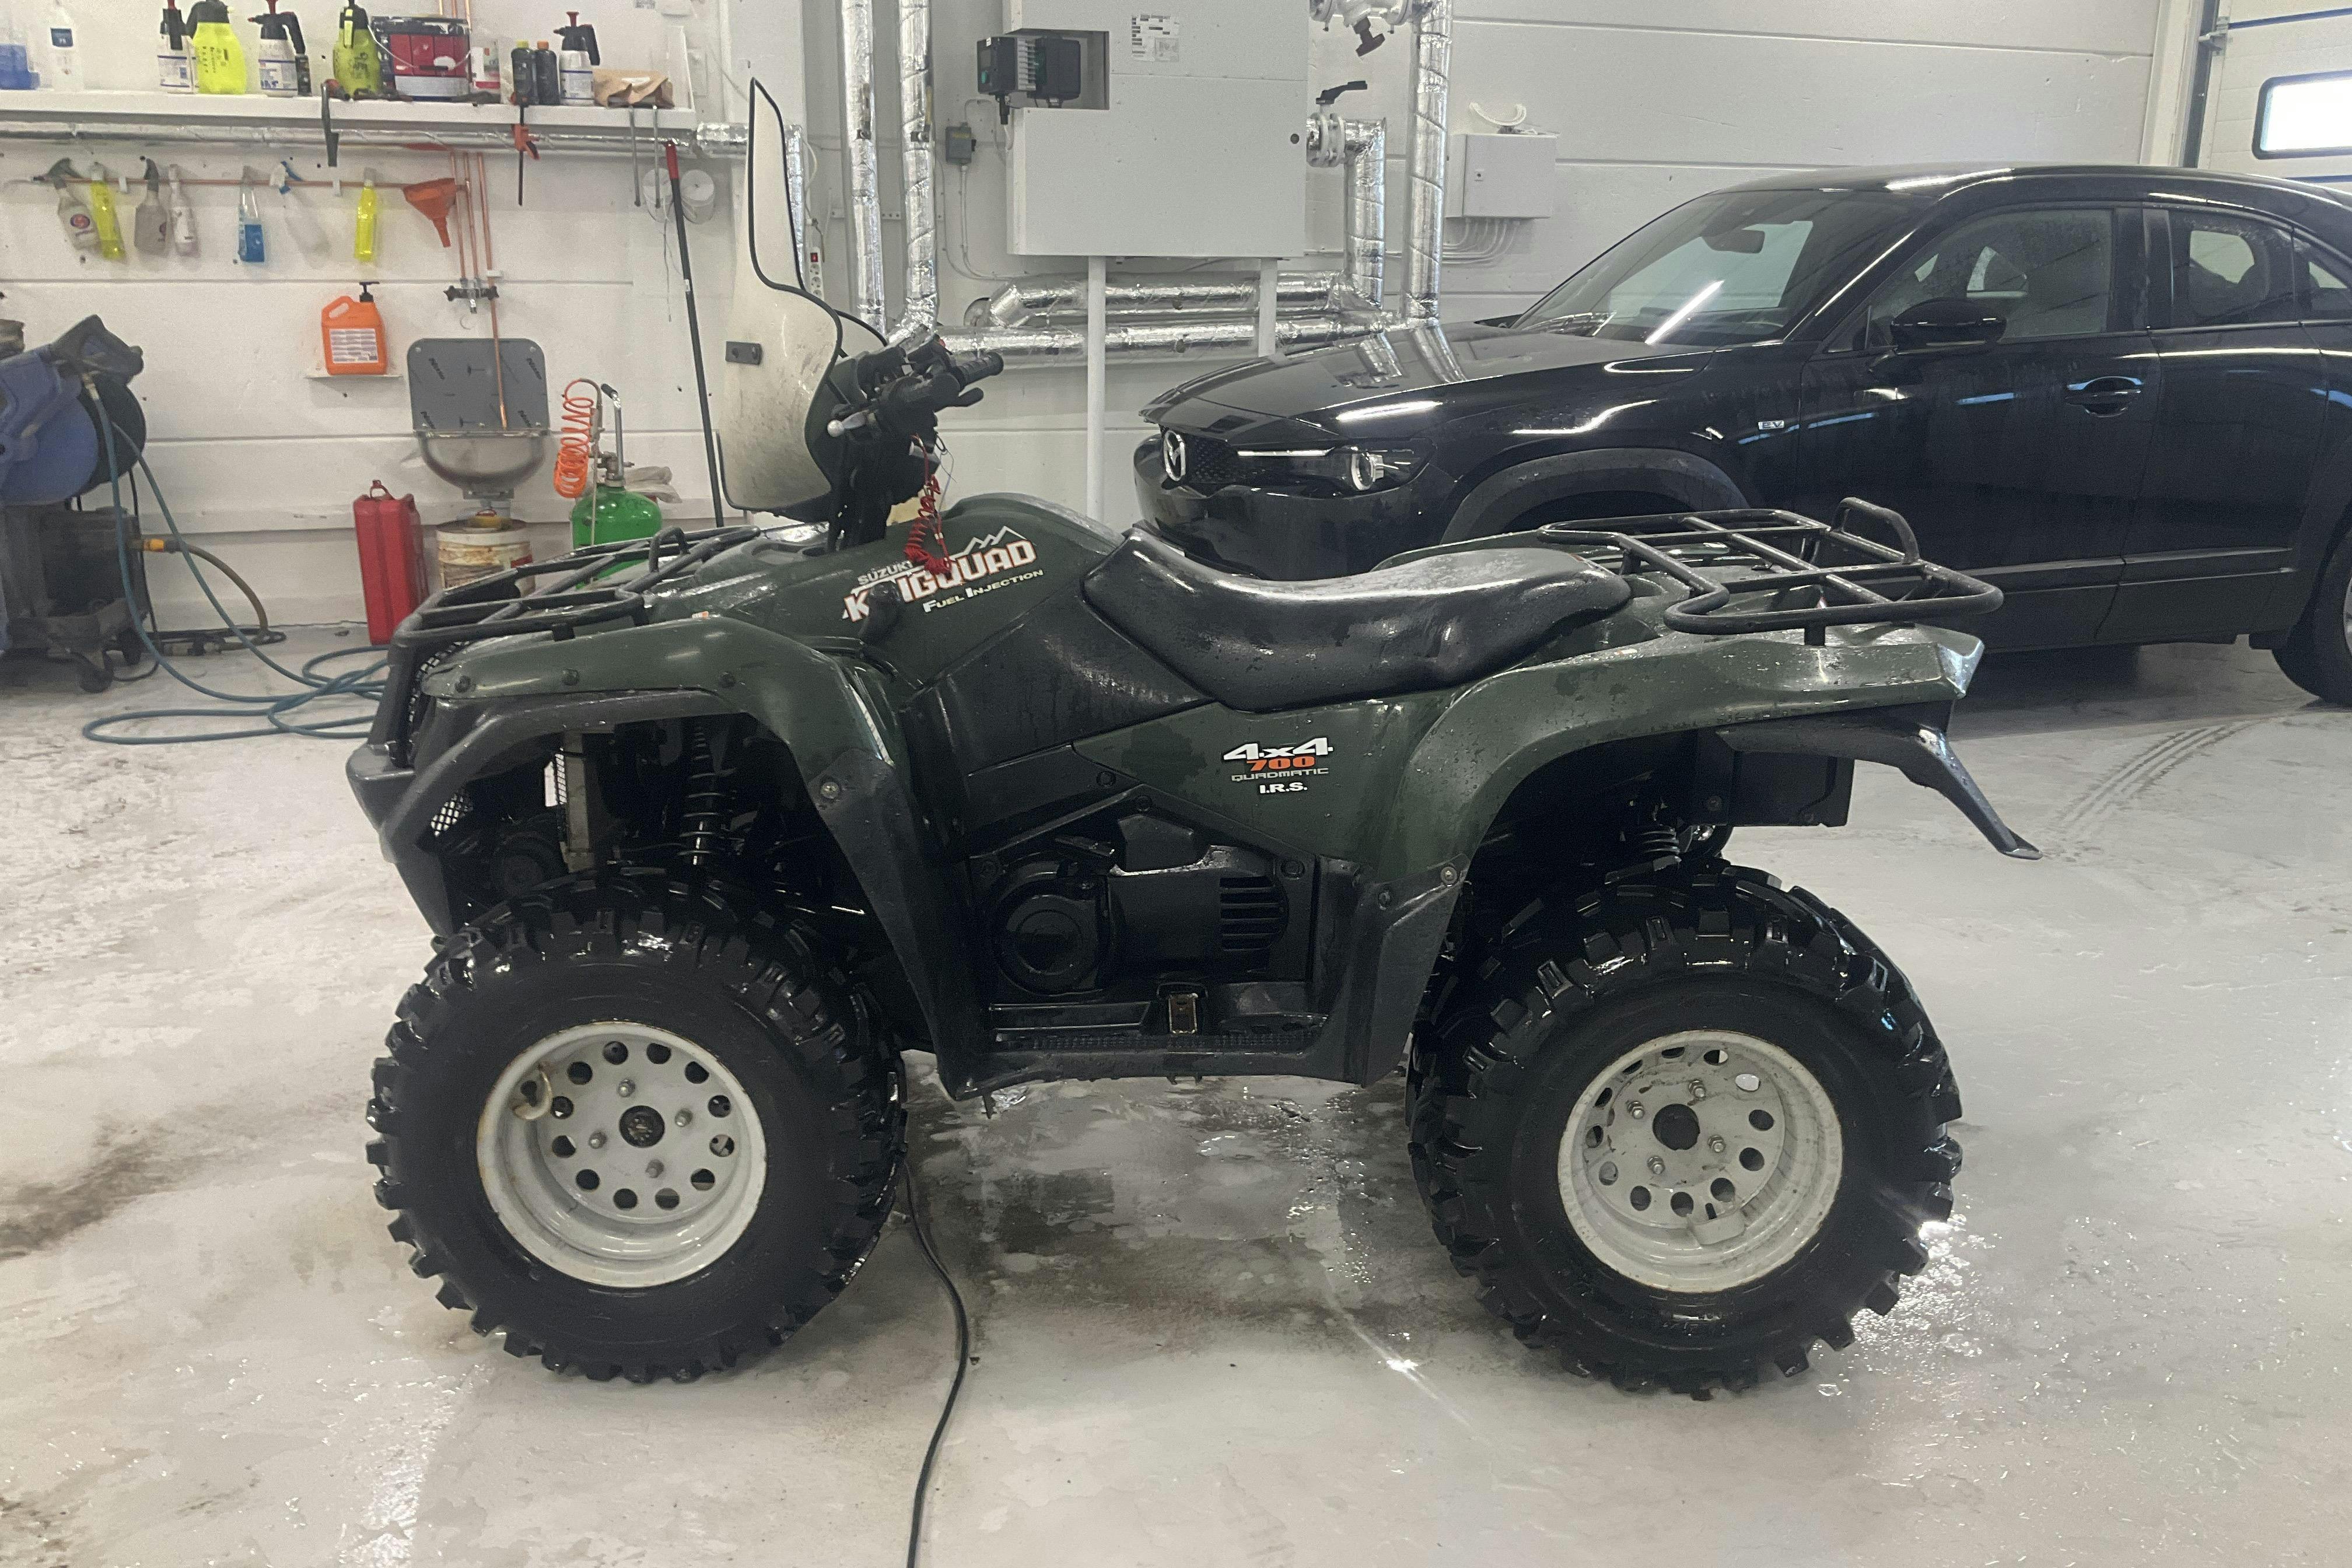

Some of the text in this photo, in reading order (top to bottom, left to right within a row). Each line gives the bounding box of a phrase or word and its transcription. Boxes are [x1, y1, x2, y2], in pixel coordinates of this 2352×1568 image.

[857, 560, 914, 585] SUZUKI
[1223, 737, 1334, 761] 4x4
[1246, 755, 1315, 772] 700
[1231, 768, 1329, 782] QUADMATIC
[1259, 782, 1308, 794] I.R.S.
